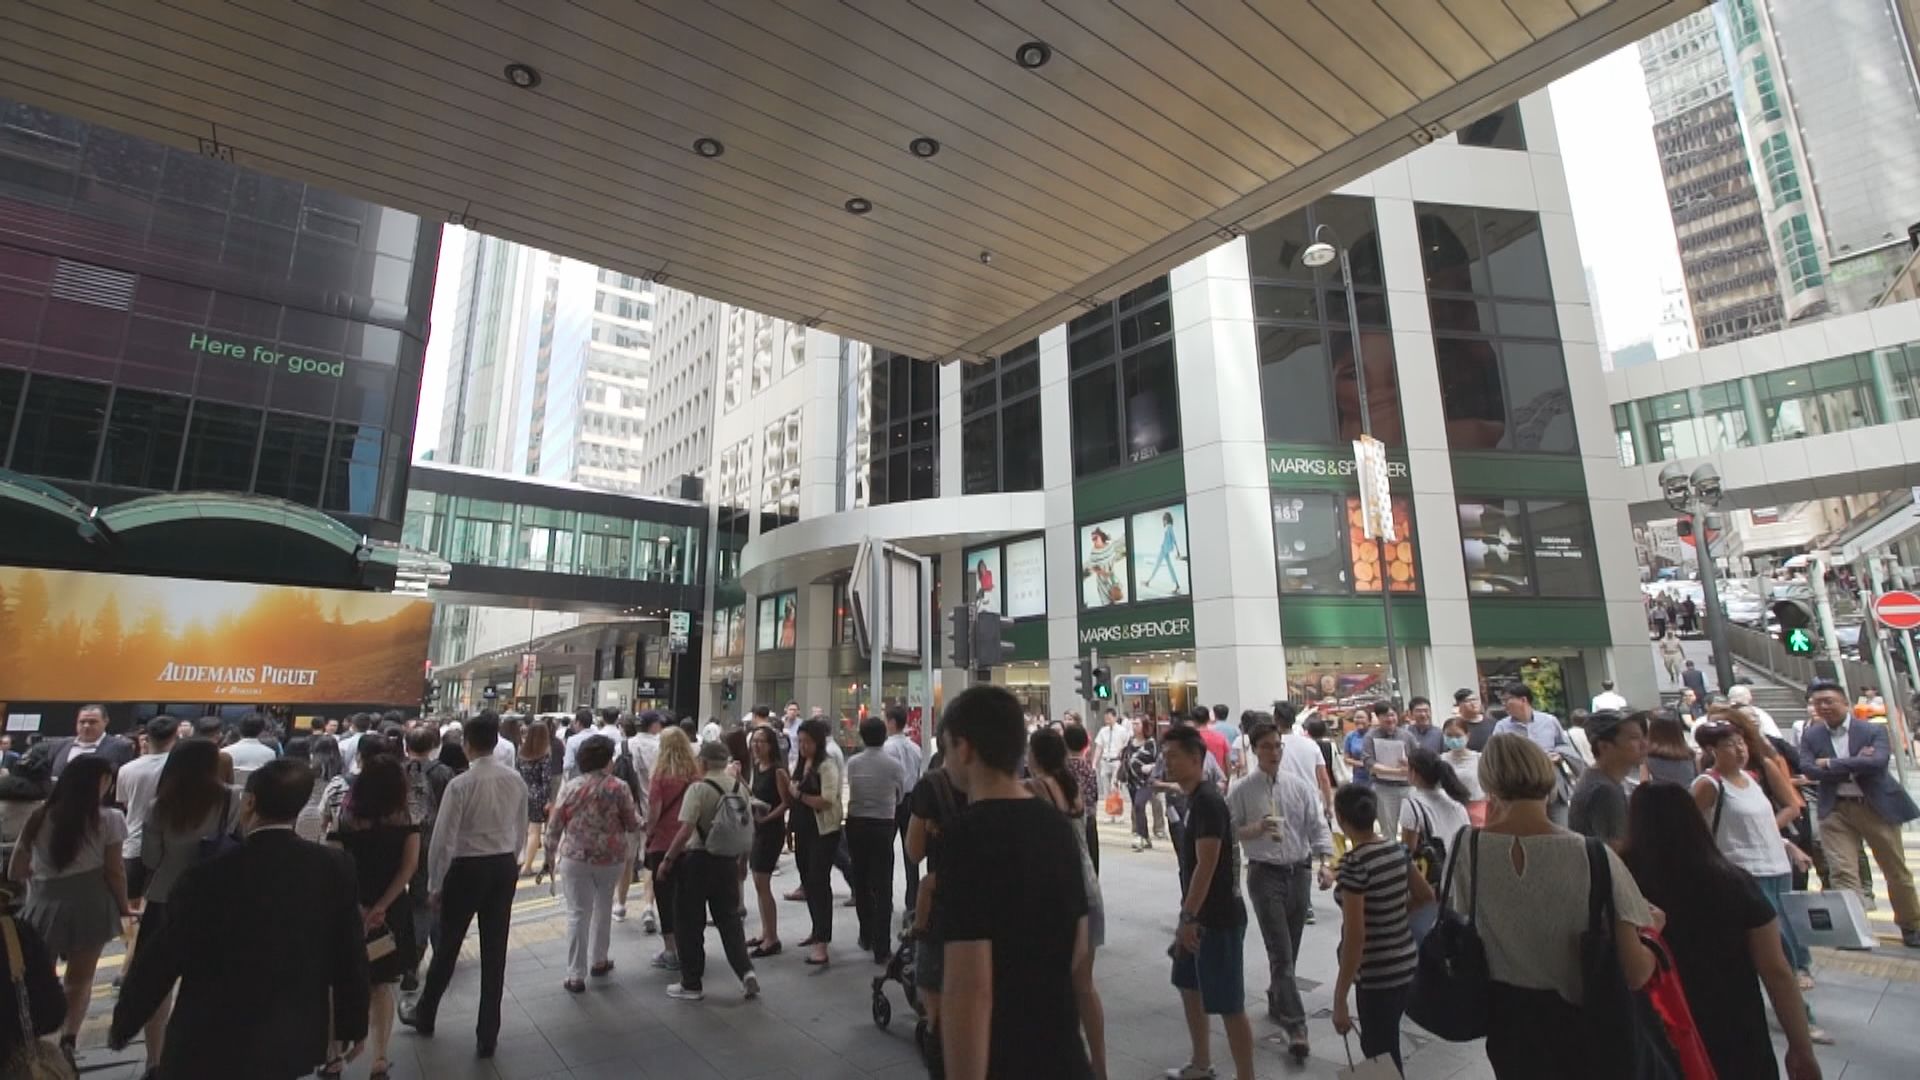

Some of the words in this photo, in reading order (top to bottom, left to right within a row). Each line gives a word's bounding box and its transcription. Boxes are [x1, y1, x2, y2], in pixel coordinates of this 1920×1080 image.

[189, 332, 246, 359] Here
[253, 346, 284, 365] for
[288, 355, 345, 377] good
[1270, 458, 1408, 478] MARKS&SPER
[157, 662, 256, 684] AUDEMARS
[261, 665, 319, 686] PIGUET
